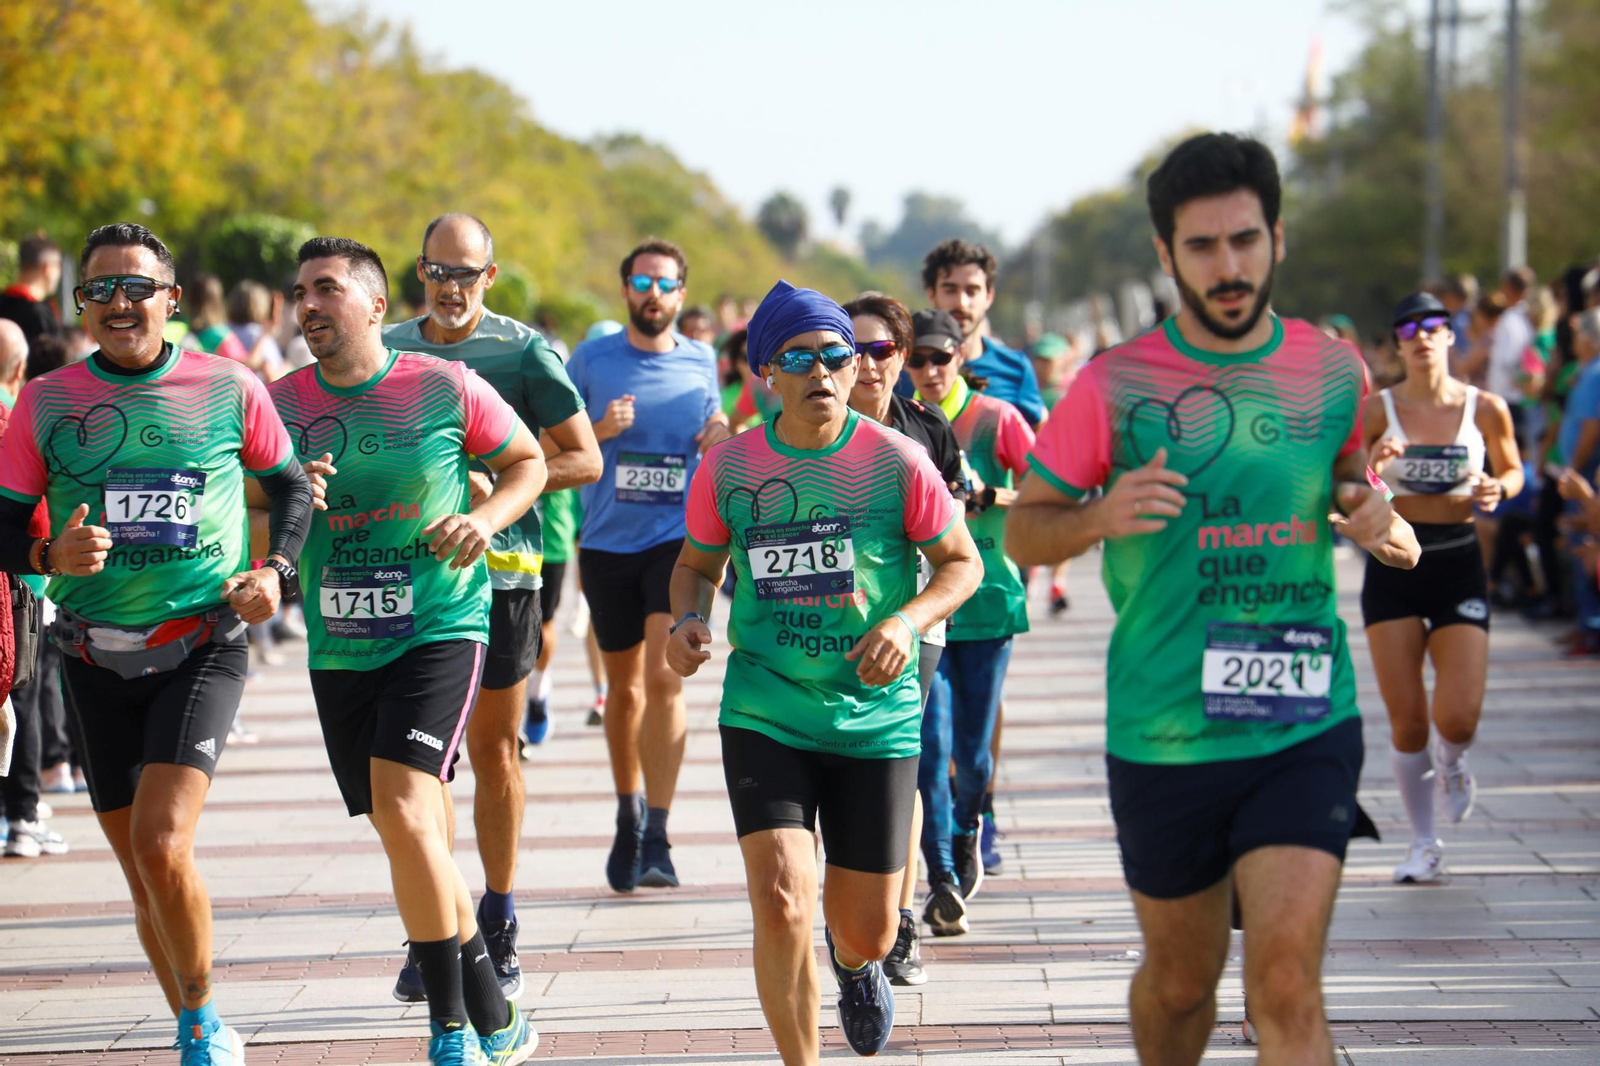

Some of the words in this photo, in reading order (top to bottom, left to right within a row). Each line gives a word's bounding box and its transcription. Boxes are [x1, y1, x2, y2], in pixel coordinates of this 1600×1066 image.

[626, 470, 676, 488] 2396
[118, 494, 189, 520] 1726
[325, 490, 357, 511] La
[1201, 493, 1240, 518] La
[328, 501, 420, 531] marcha
[120, 524, 146, 532] marcha
[120, 530, 156, 540] engancha
[778, 530, 800, 538] cáncer
[786, 523, 811, 533] marcha
[328, 538, 437, 567] enganch
[764, 546, 838, 573] 2718
[1198, 555, 1266, 583] que
[771, 579, 798, 587] marcha
[773, 584, 809, 595] engancha
[330, 591, 398, 615] 1715
[335, 620, 358, 628] marcha
[773, 610, 822, 630] que
[338, 626, 367, 635] engancha
[1223, 656, 1304, 689] 2021
[816, 738, 846, 749] Contra
[849, 740, 857, 749] el
[858, 738, 889, 749] Cáncer
